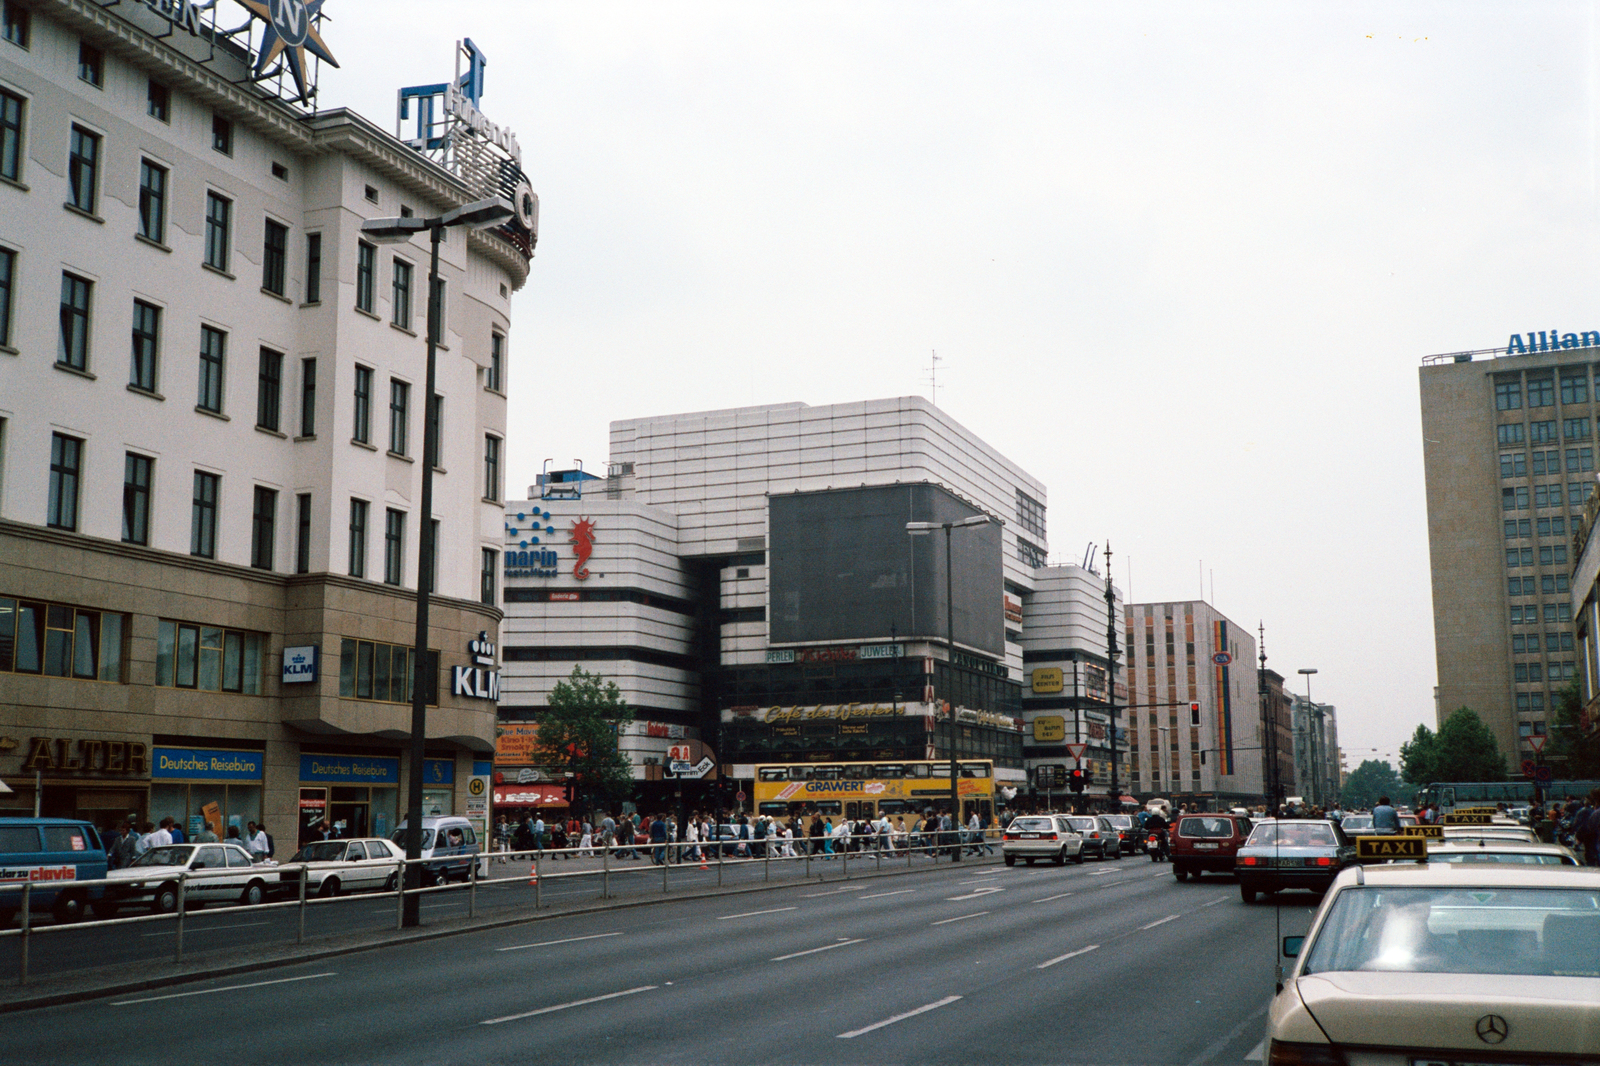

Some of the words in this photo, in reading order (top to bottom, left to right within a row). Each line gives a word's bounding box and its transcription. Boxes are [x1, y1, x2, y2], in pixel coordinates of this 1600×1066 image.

[767, 650, 794, 663] PERLEN
[284, 664, 313, 675] KLM
[451, 665, 500, 701] KLM
[764, 704, 803, 724] Café
[806, 704, 831, 719] des
[834, 702, 906, 721] Westens
[23, 736, 148, 774] ALTER
[160, 755, 209, 771] Deutsches
[210, 756, 256, 773] Reisebüro
[311, 761, 350, 775] Deutsches
[351, 763, 387, 776] Reisebüro
[805, 781, 865, 793] GRAWERT
[1452, 815, 1485, 823] TAXI
[1410, 828, 1438, 836] TAXI
[1368, 841, 1415, 854] TAXI
[17, 870, 29, 878] zu
[30, 865, 76, 881] clavis
